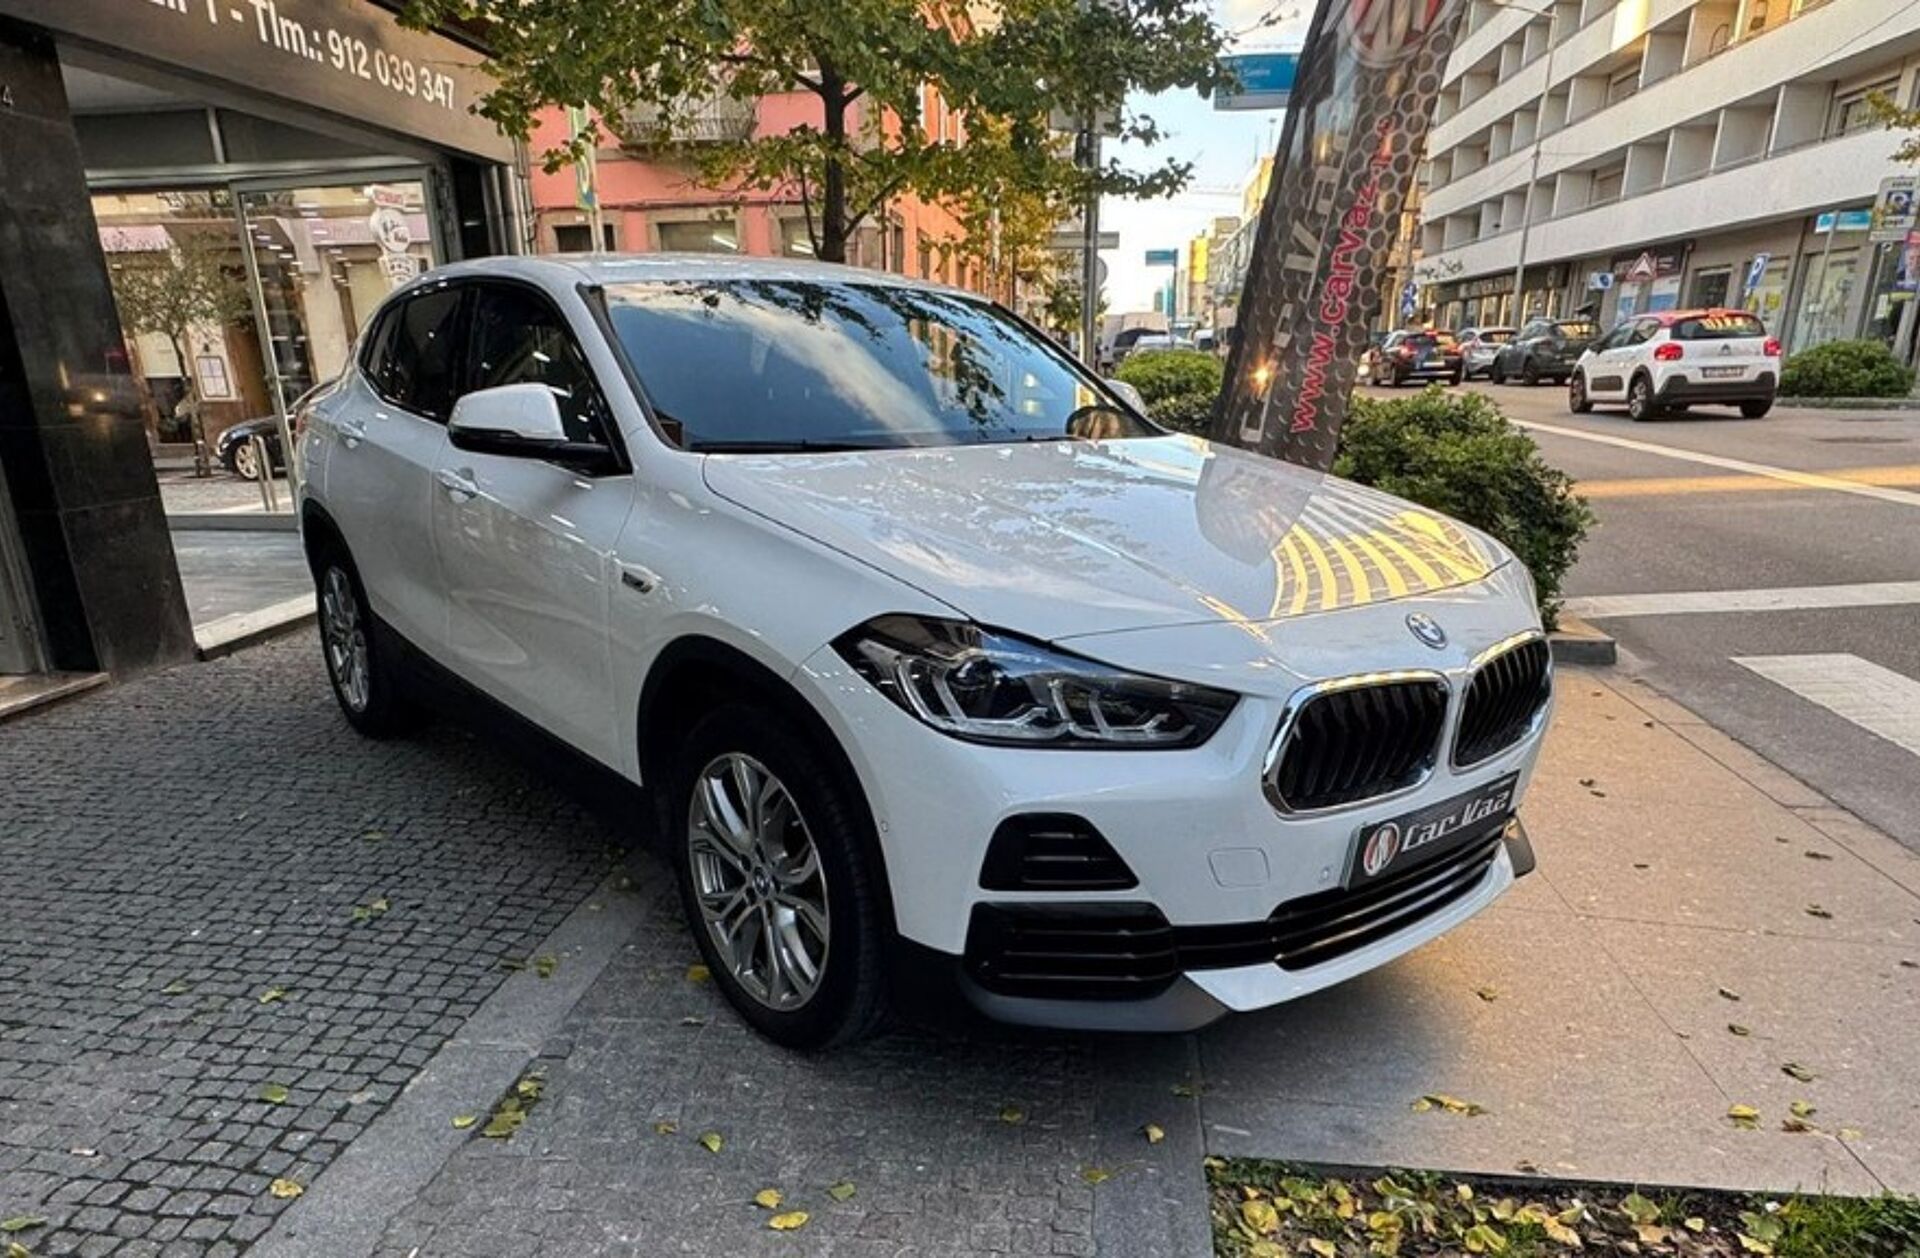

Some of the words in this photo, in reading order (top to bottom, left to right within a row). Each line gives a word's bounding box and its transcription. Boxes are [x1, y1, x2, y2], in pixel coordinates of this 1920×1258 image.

[327, 28, 371, 80] 912
[374, 49, 417, 96] 039
[420, 66, 455, 109] 347
